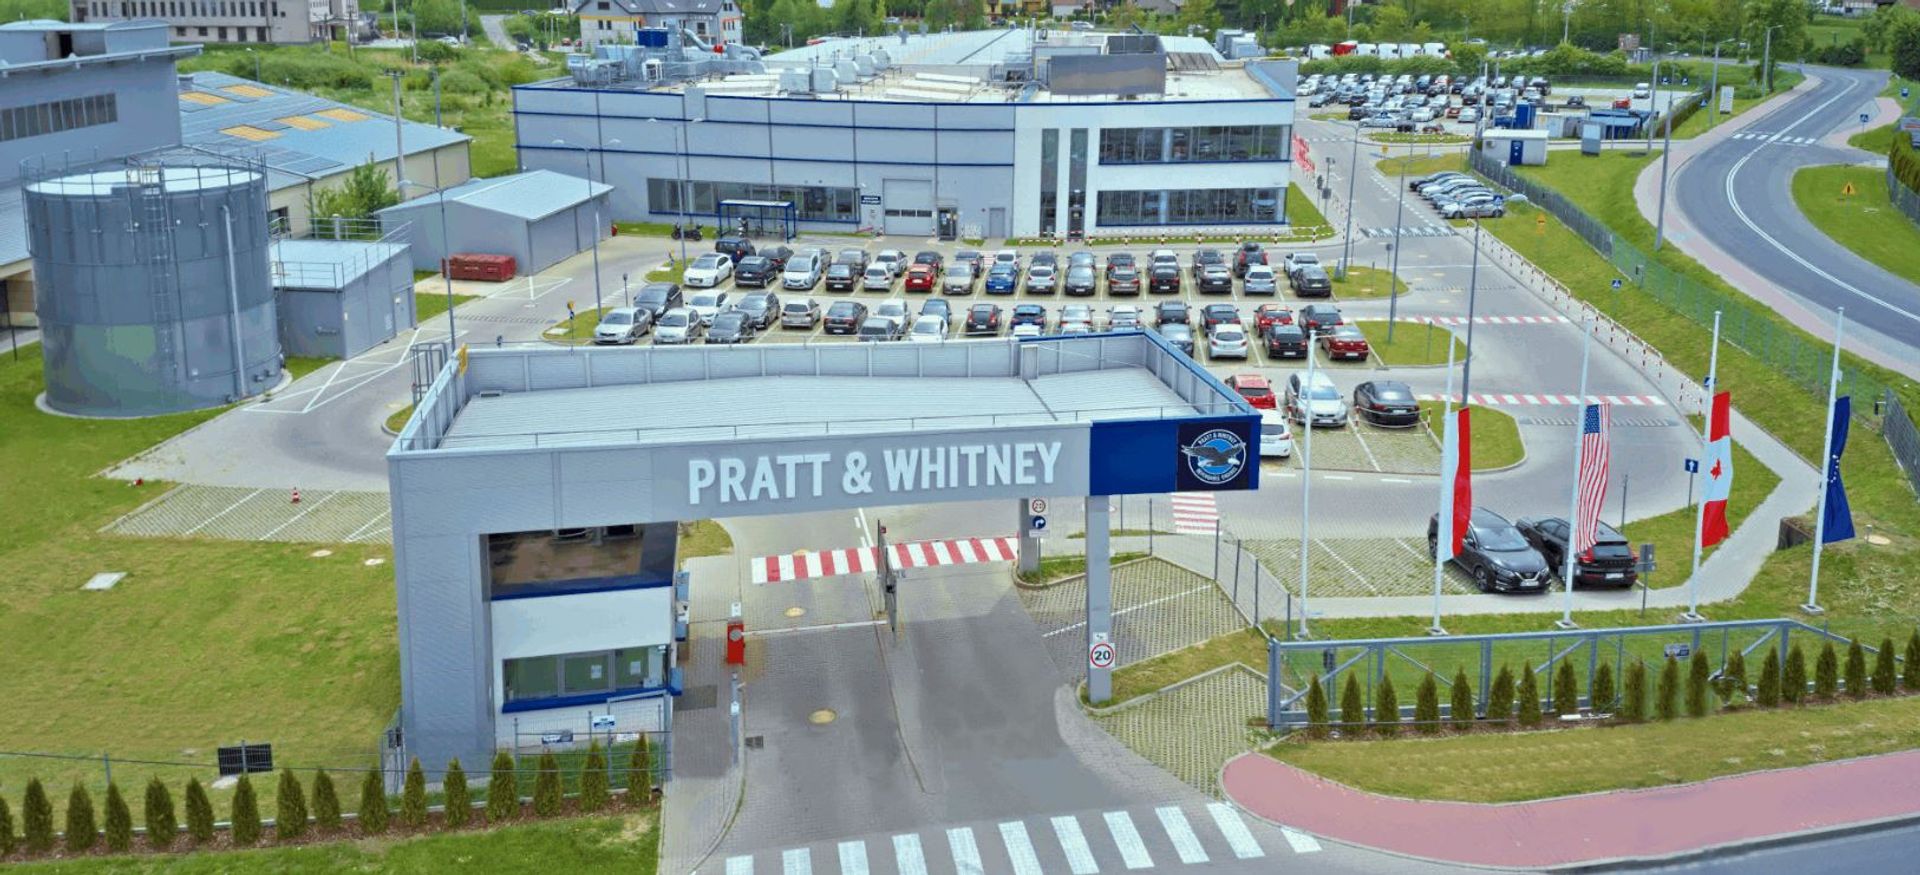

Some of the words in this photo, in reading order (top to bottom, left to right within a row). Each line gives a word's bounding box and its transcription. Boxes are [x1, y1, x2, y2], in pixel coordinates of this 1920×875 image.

[688, 453, 831, 505] PRATT
[842, 451, 873, 495] &
[883, 441, 1062, 492] WHITNEY
[1094, 650, 1111, 661] 20
